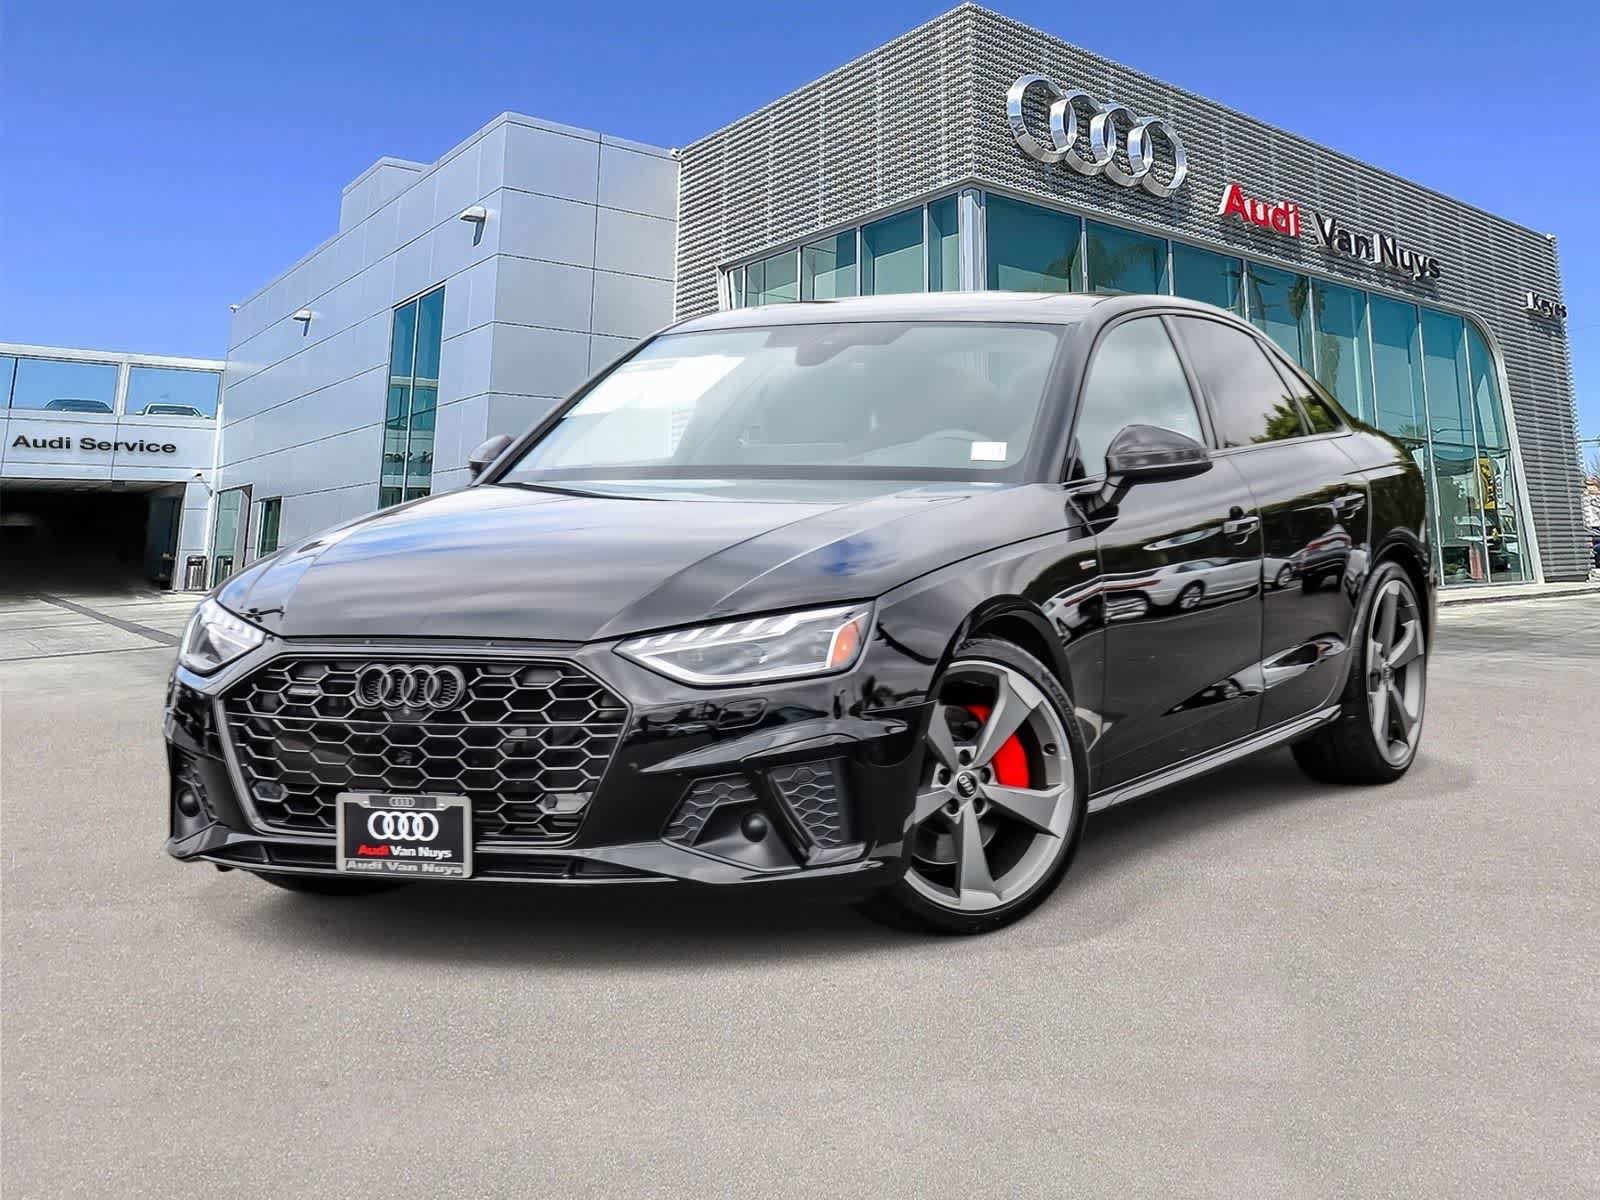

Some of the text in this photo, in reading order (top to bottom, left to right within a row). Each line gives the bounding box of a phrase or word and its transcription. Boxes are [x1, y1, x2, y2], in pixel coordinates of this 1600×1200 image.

[1217, 183, 1441, 280] Audi Van Nuys
[12, 435, 177, 453] Audi Service
[357, 844, 452, 860] Audi Van Nuys
[347, 860, 463, 875] Audi Van Nuys
